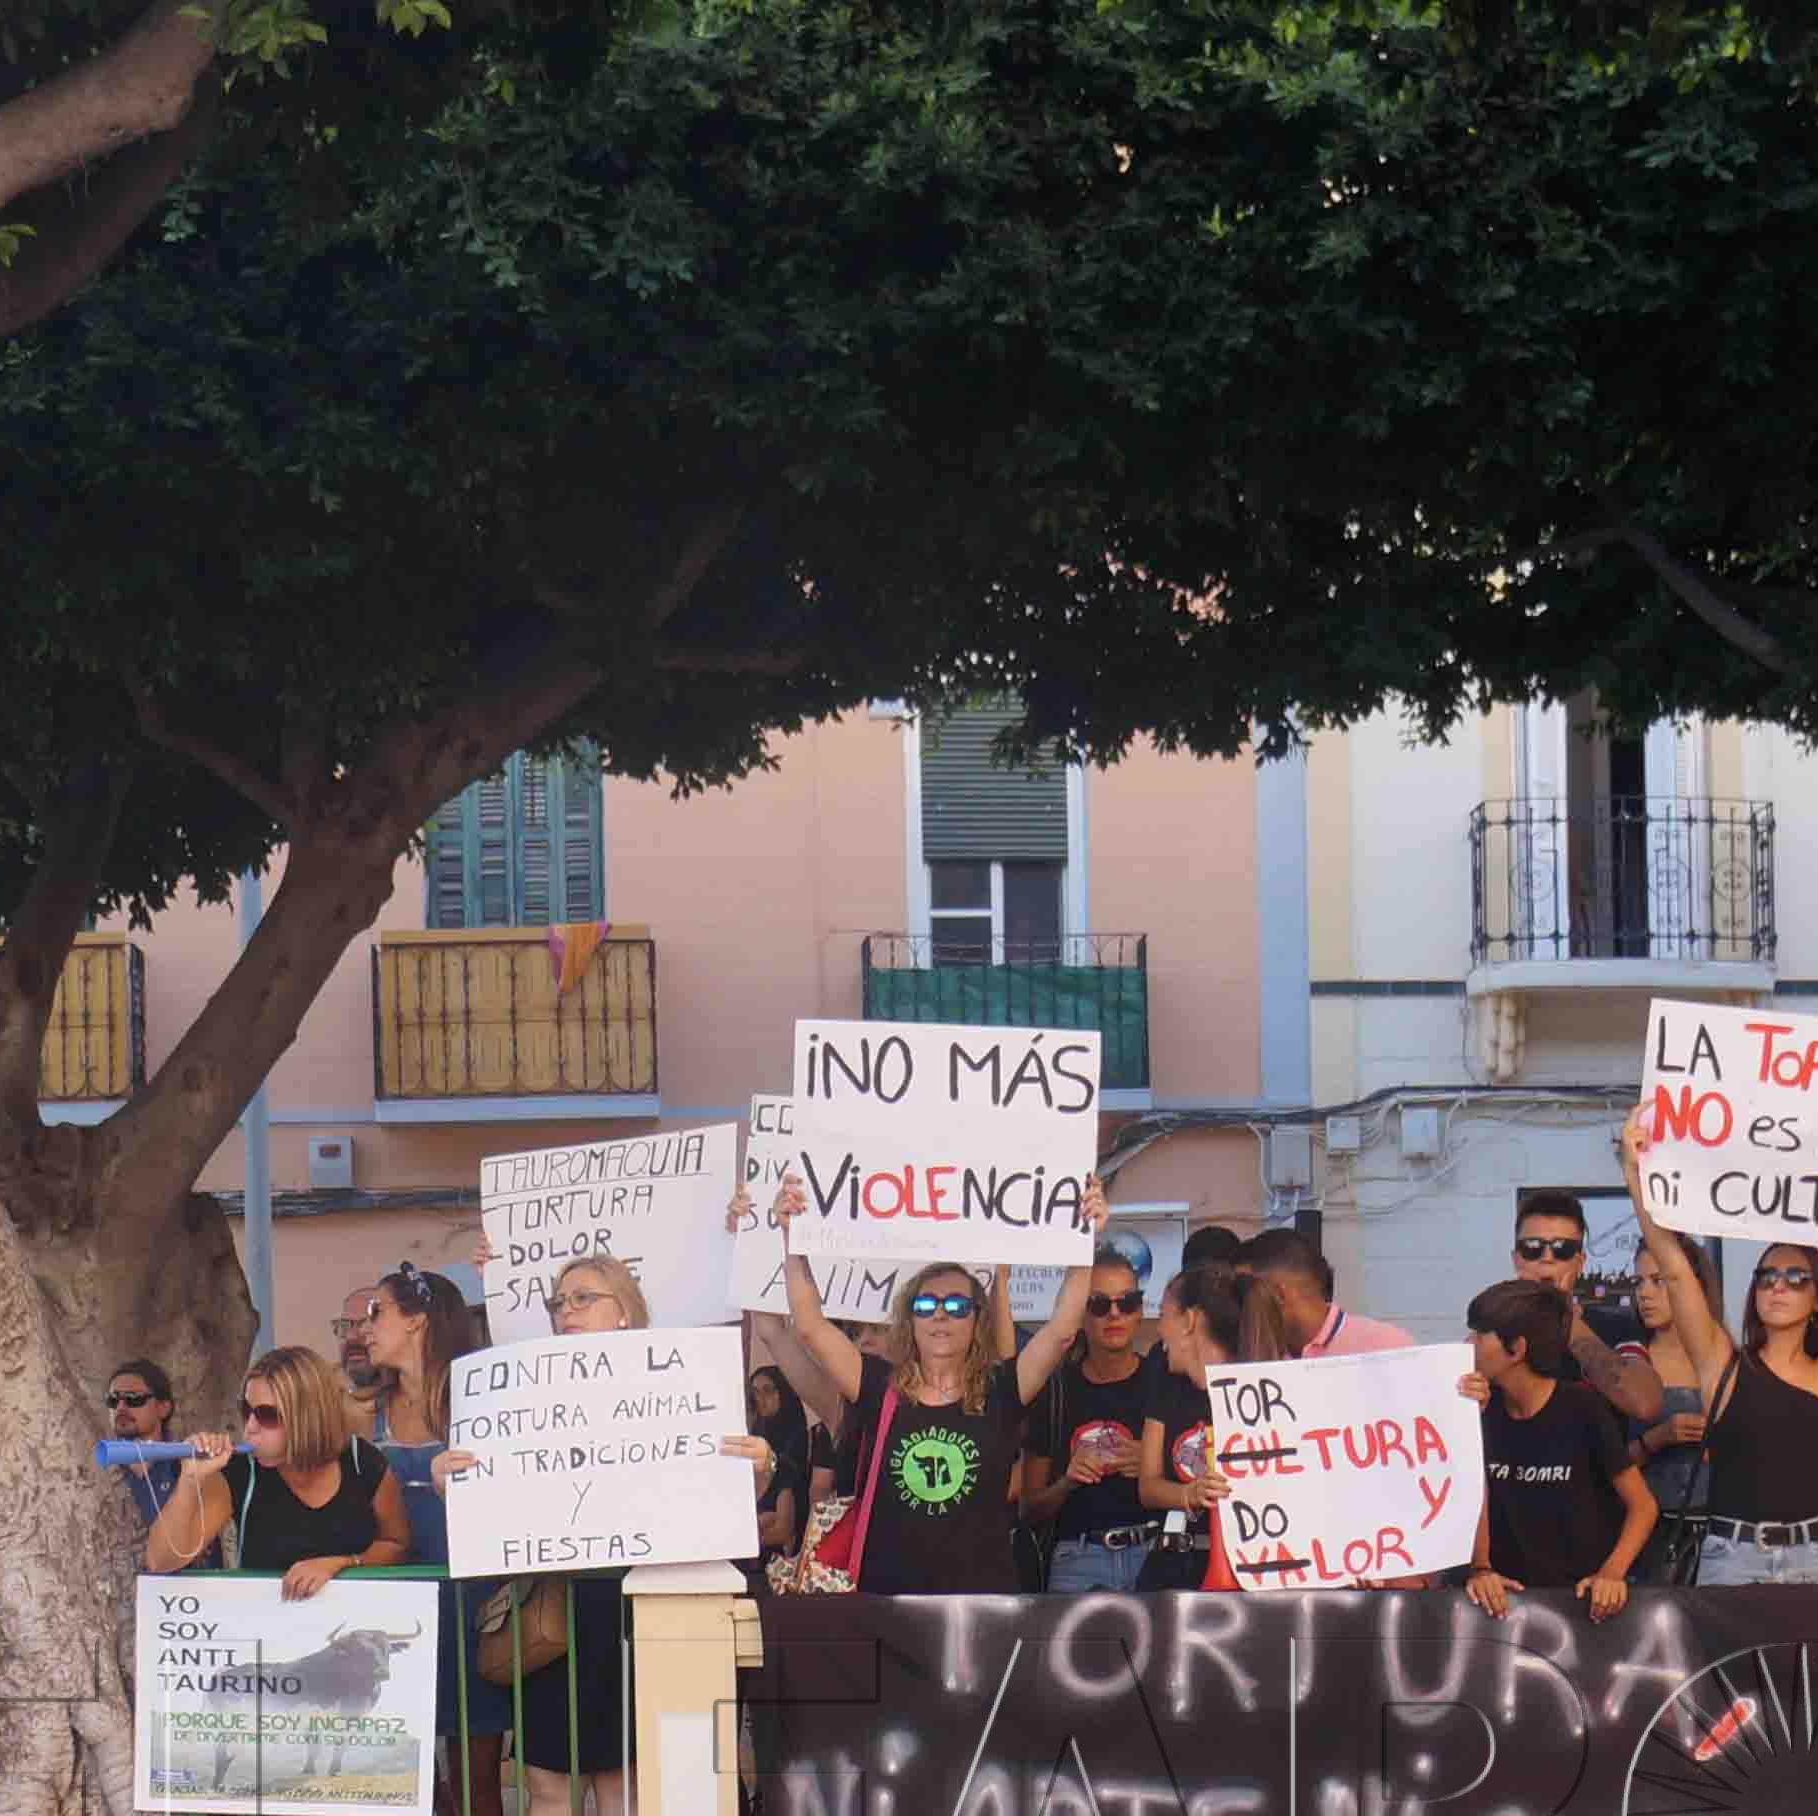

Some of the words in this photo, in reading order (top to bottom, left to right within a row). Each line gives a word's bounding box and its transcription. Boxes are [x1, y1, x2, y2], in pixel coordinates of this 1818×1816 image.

[1656, 1015, 1722, 1082] LA
[949, 1033, 1095, 1113] MÁS
[1652, 1084, 1734, 1148] NO
[465, 1350, 615, 1397] CONTRA
[646, 1345, 685, 1371] LA
[450, 1403, 589, 1445] TORTURA
[613, 1391, 717, 1420] ANIMAL
[1211, 1377, 1297, 1427] TOR
[511, 1433, 717, 1475] TRADICIONES
[1218, 1415, 1448, 1479] CULTURA
[1418, 1476, 1452, 1530] Y
[571, 1480, 592, 1526] Y
[1232, 1500, 1289, 1542] DO
[502, 1532, 653, 1568] FIESTAS
[1235, 1527, 1414, 1586] VALOR
[158, 1595, 201, 1615] YO
[157, 1621, 220, 1641] SOY
[156, 1647, 238, 1668] ANTI
[891, 1591, 1701, 1752] TORTURA
[156, 1672, 303, 1696] TAURINO
[164, 1711, 248, 1730] PORQUE
[258, 1712, 302, 1731] SOY
[307, 1713, 408, 1735] INCAPAZ
